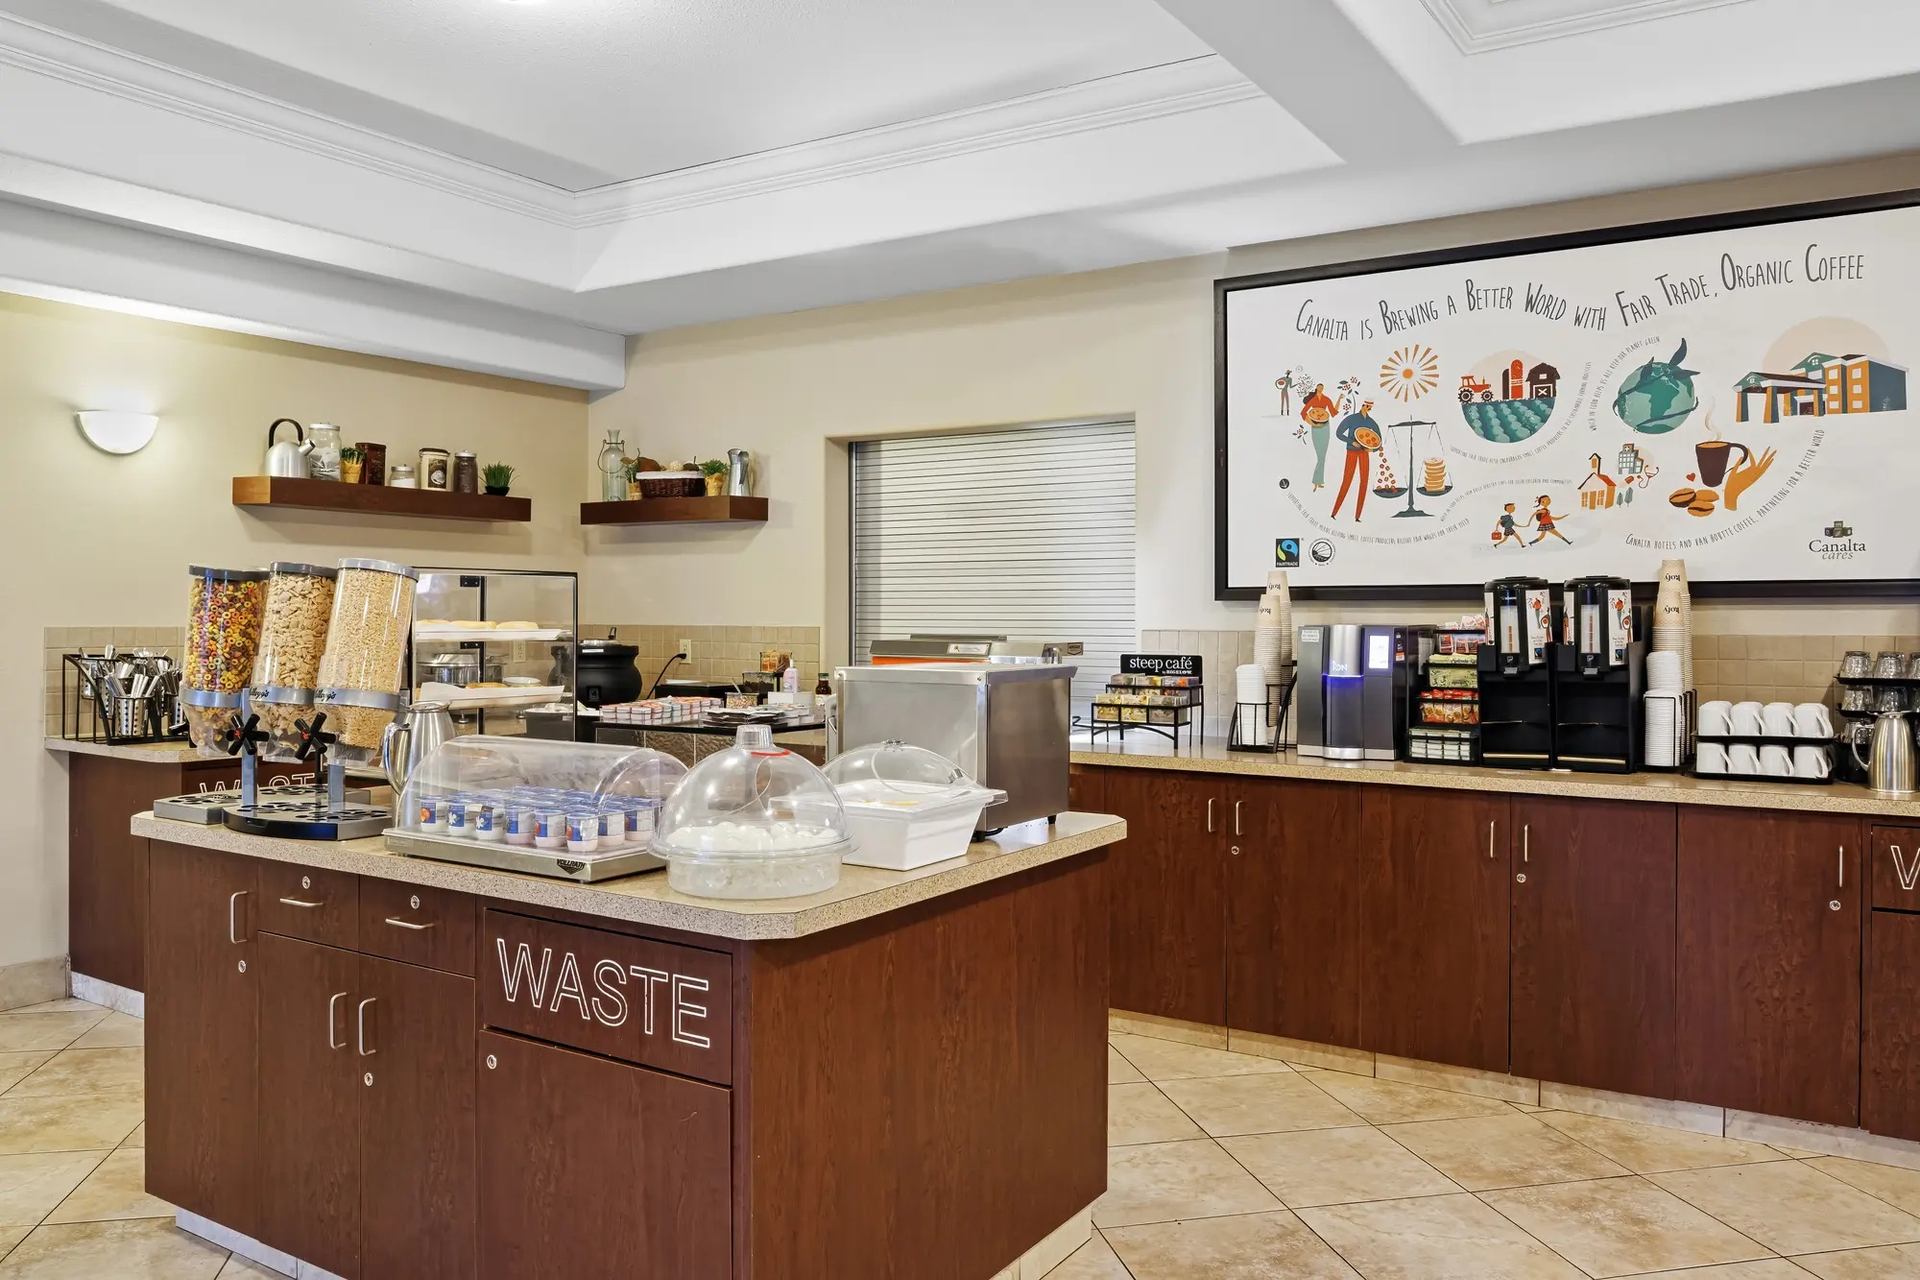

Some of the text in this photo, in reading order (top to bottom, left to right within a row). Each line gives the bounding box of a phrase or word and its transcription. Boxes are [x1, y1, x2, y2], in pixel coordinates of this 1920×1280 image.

[1296, 299, 1347, 341] CANALTA
[1361, 319, 1373, 340] IS
[1379, 300, 1438, 334] BREWING
[1448, 295, 1457, 315] A
[1466, 279, 1513, 311] BETTER
[1525, 283, 1566, 320] WORLD
[1574, 306, 1606, 331] WITH
[1615, 291, 1656, 326] FAIR
[1721, 253, 1793, 290] ORGANIC
[1806, 244, 1864, 282] COFFEE
[1678, 538, 1692, 548] AND
[1808, 539, 1866, 552] Canalta
[1822, 552, 1854, 560] cares
[1130, 656, 1192, 672] steep café
[496, 938, 710, 1048] WASTE
